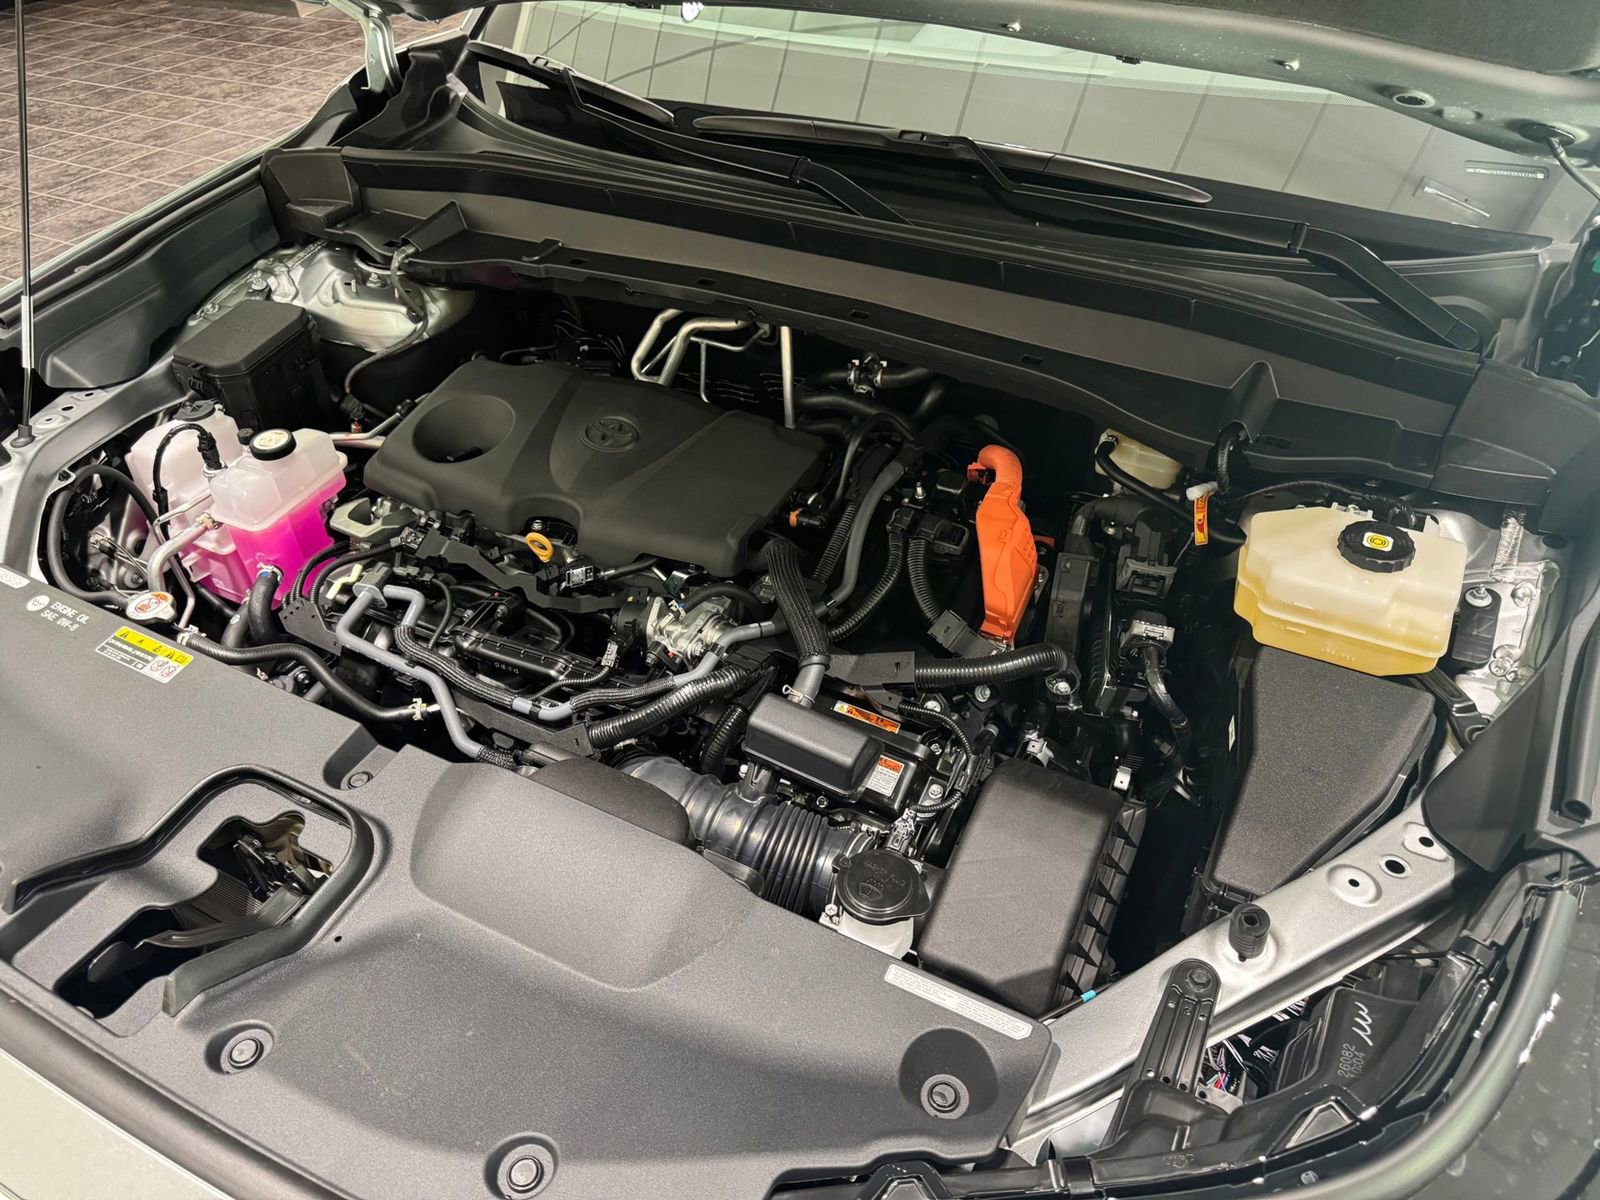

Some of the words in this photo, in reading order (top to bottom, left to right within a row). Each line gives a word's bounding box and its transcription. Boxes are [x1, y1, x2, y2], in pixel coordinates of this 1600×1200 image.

[41, 609, 59, 621] SAE
[51, 601, 79, 618] ENGINE
[76, 613, 90, 625] OIL
[1337, 1043, 1355, 1078] 26082
